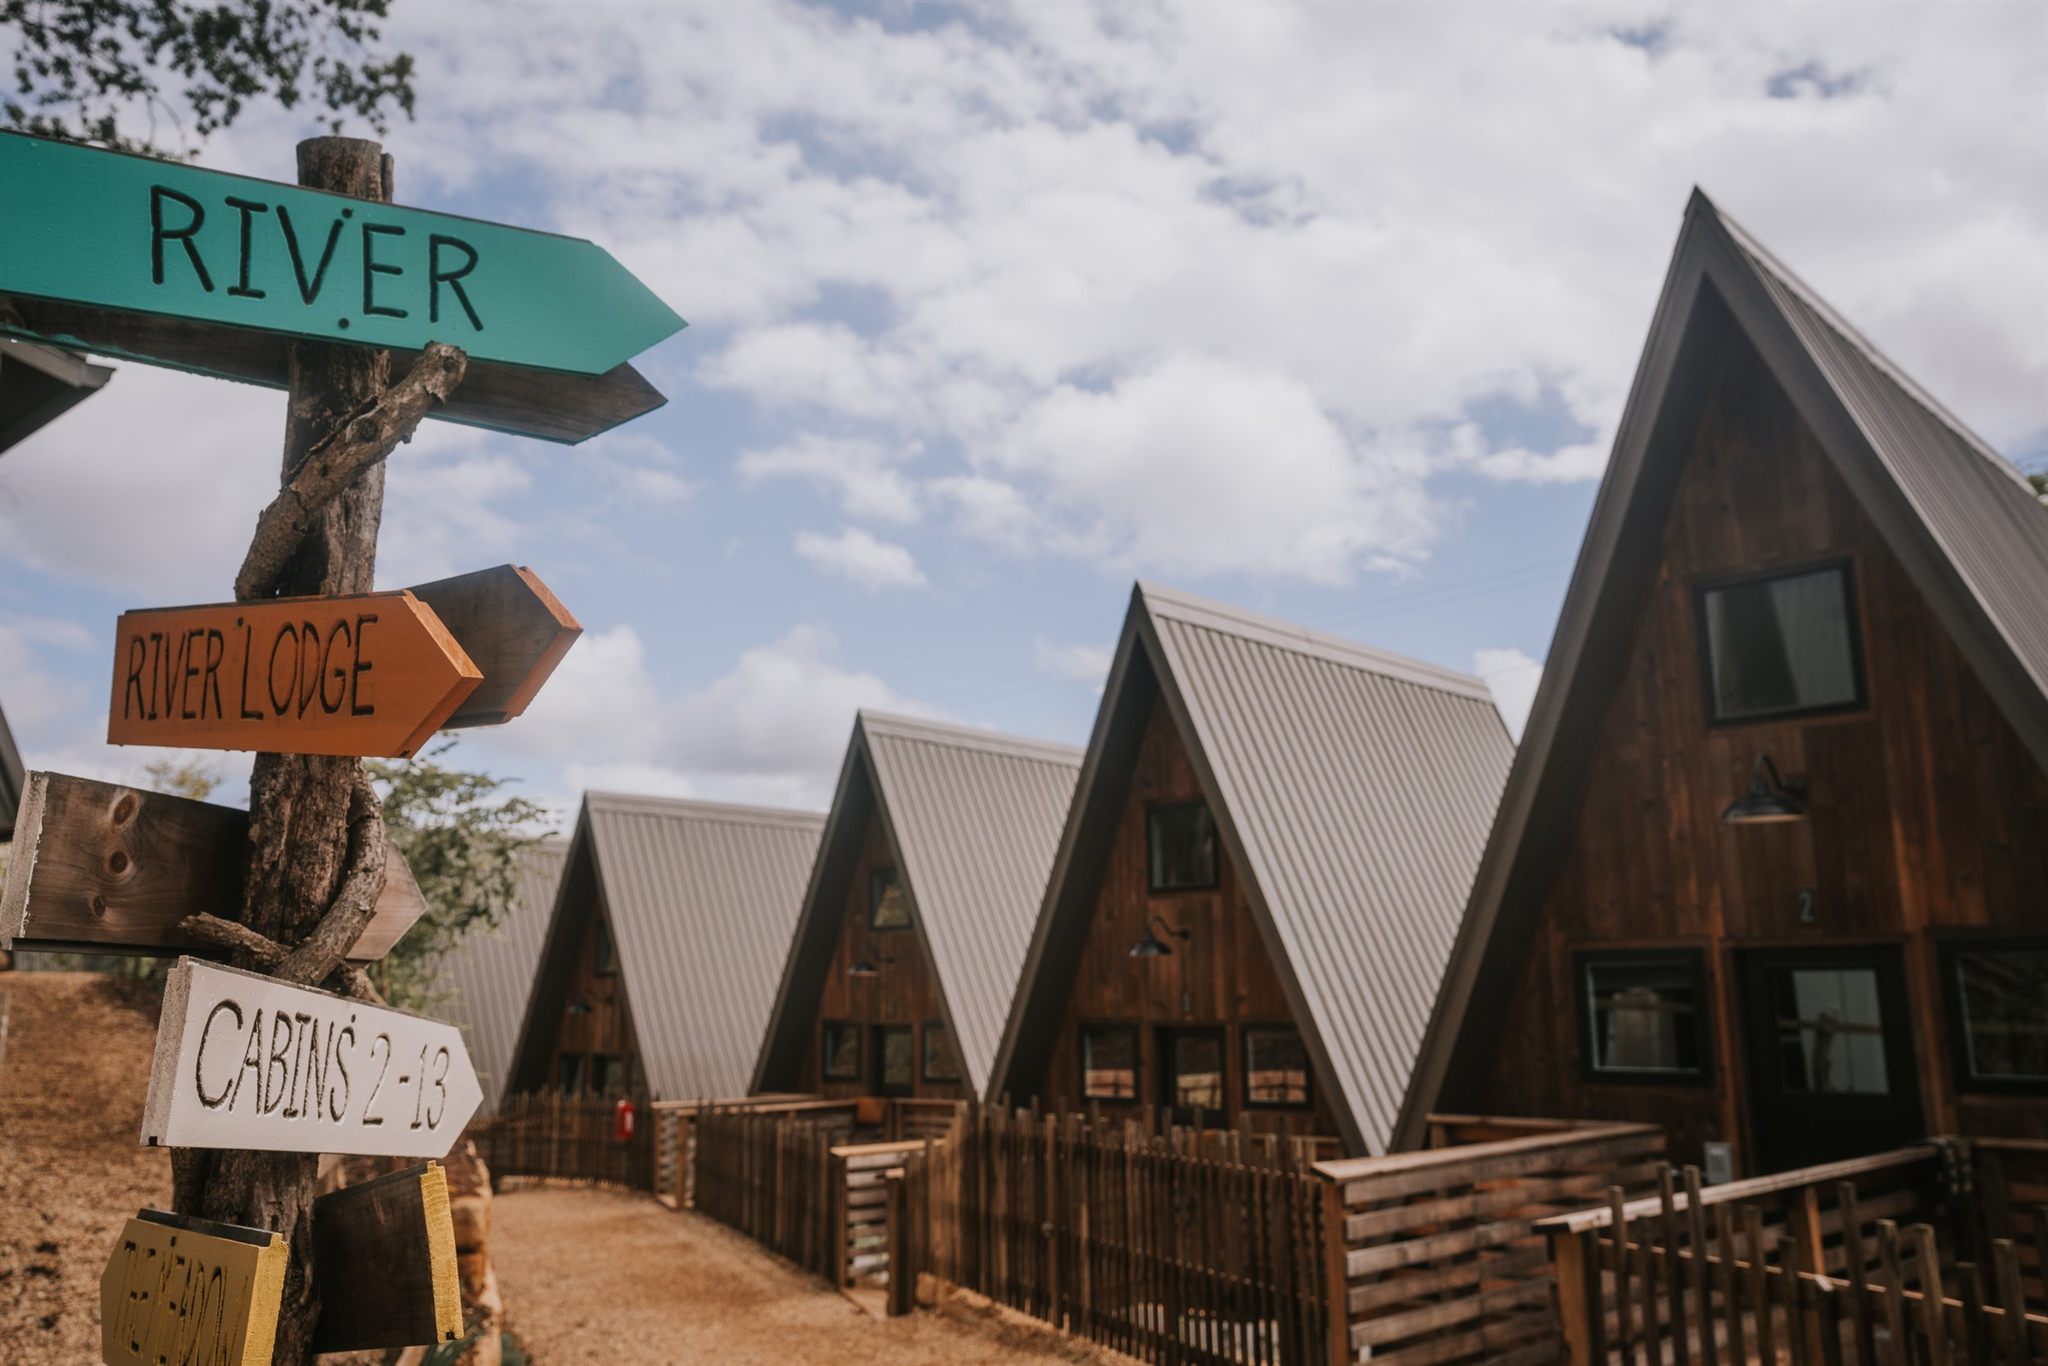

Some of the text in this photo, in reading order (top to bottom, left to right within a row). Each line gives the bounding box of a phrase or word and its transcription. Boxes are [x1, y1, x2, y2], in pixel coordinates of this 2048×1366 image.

[149, 184, 485, 331] RIVER
[124, 613, 379, 721] RIVER LODGE
[1798, 891, 1816, 923] 2
[195, 998, 450, 1131] CABINS 2-13
